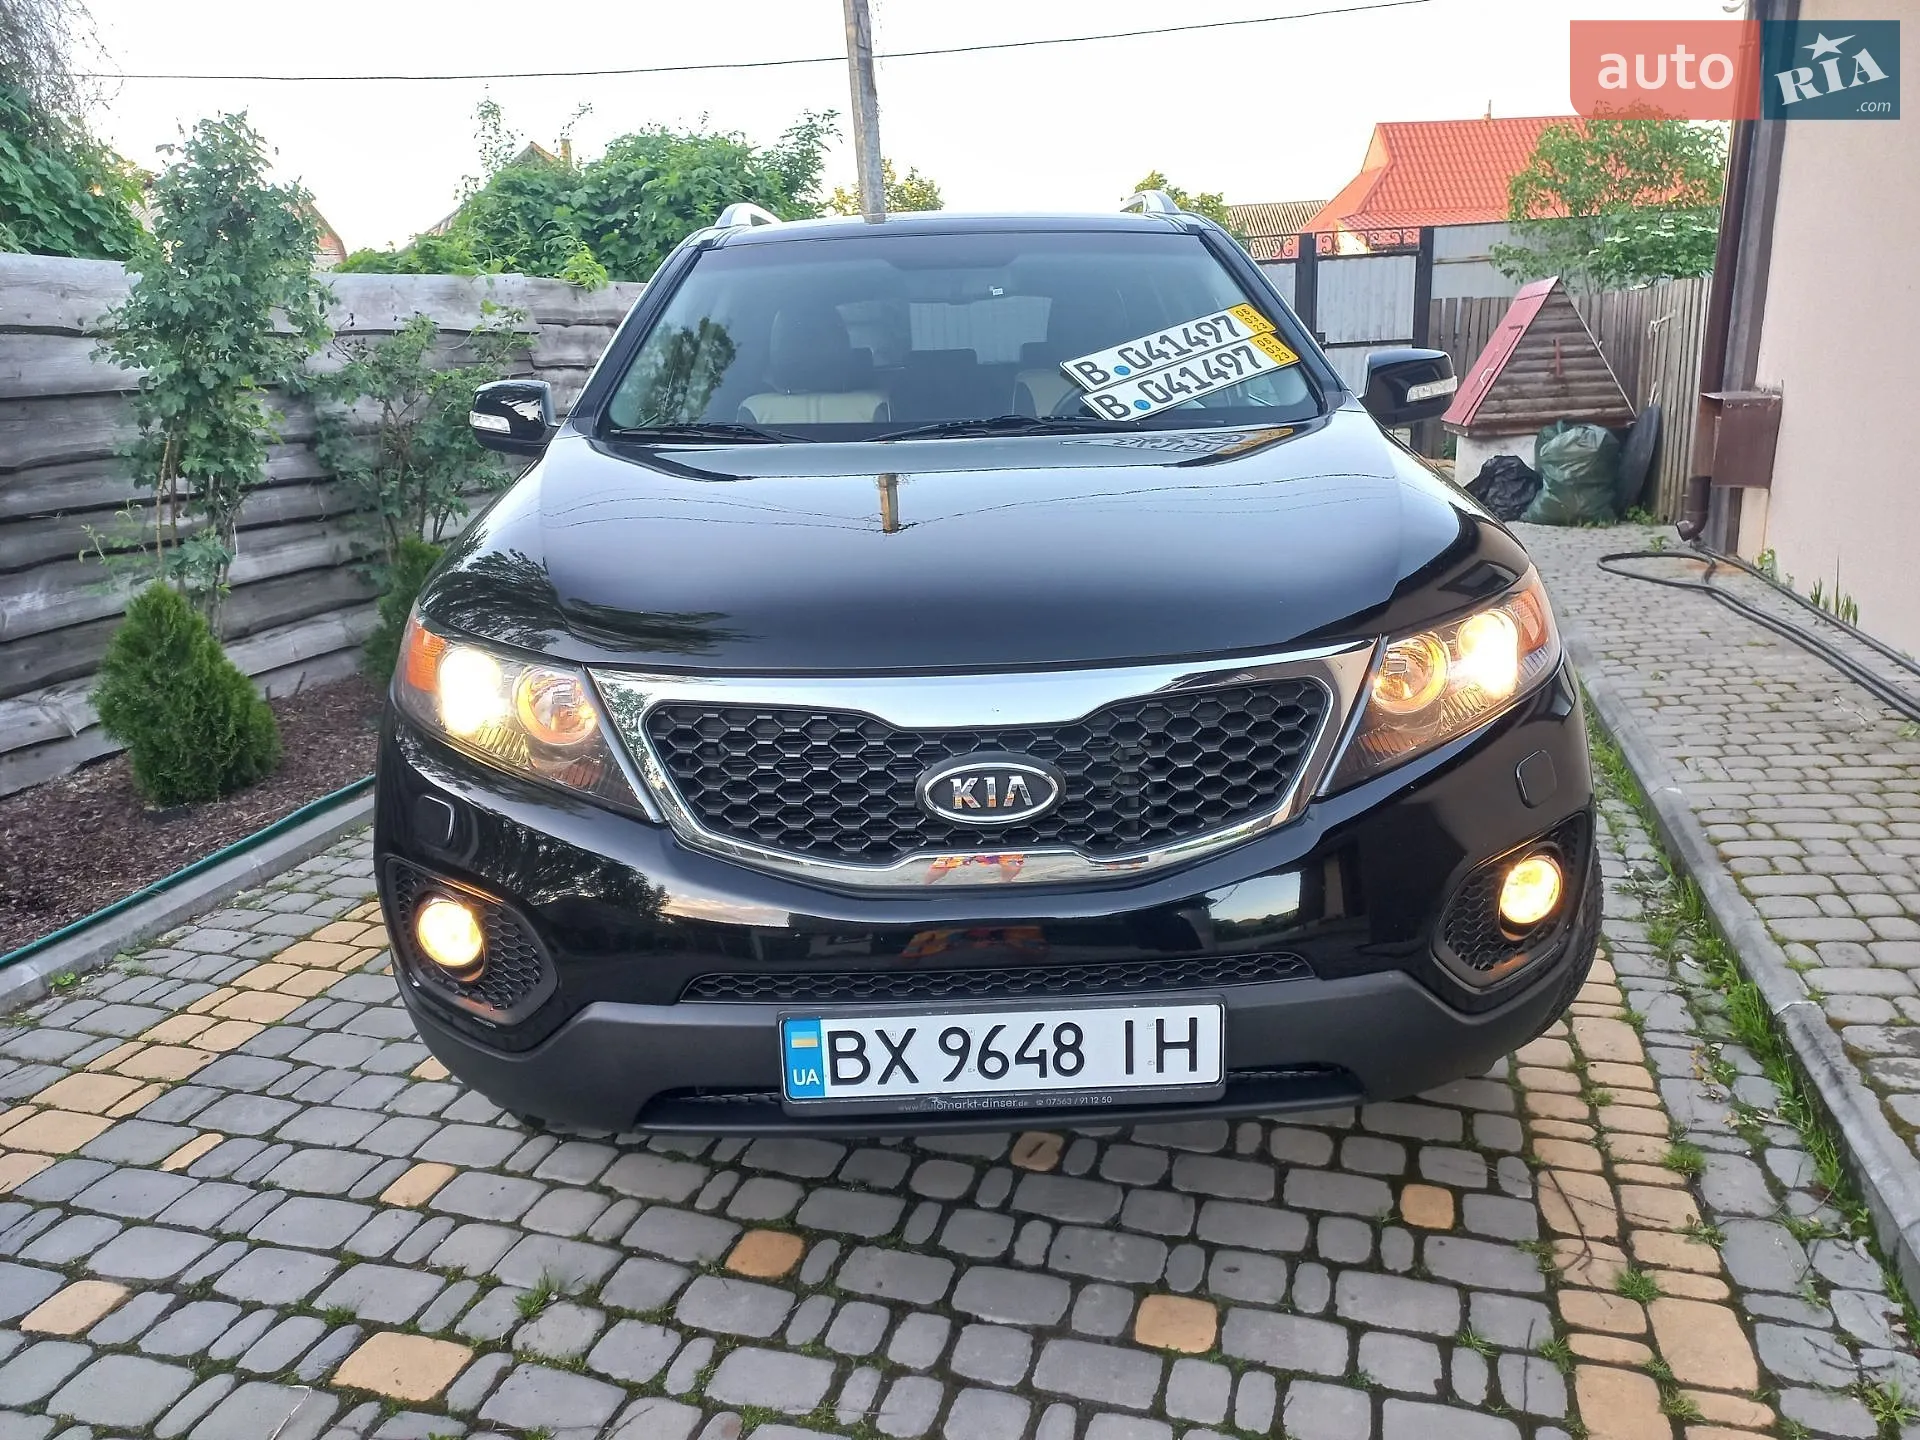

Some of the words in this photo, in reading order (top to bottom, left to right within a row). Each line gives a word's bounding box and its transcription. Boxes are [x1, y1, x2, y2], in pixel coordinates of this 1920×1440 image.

[1074, 361, 1111, 386] B
[1117, 314, 1241, 370] 041497
[1093, 393, 1132, 420] B
[1137, 344, 1262, 404] 041497
[950, 775, 1034, 810] KIA
[792, 1068, 821, 1086] UA
[827, 1027, 920, 1086] BX
[938, 1021, 1085, 1083] 9648
[1125, 1016, 1199, 1075] IH
